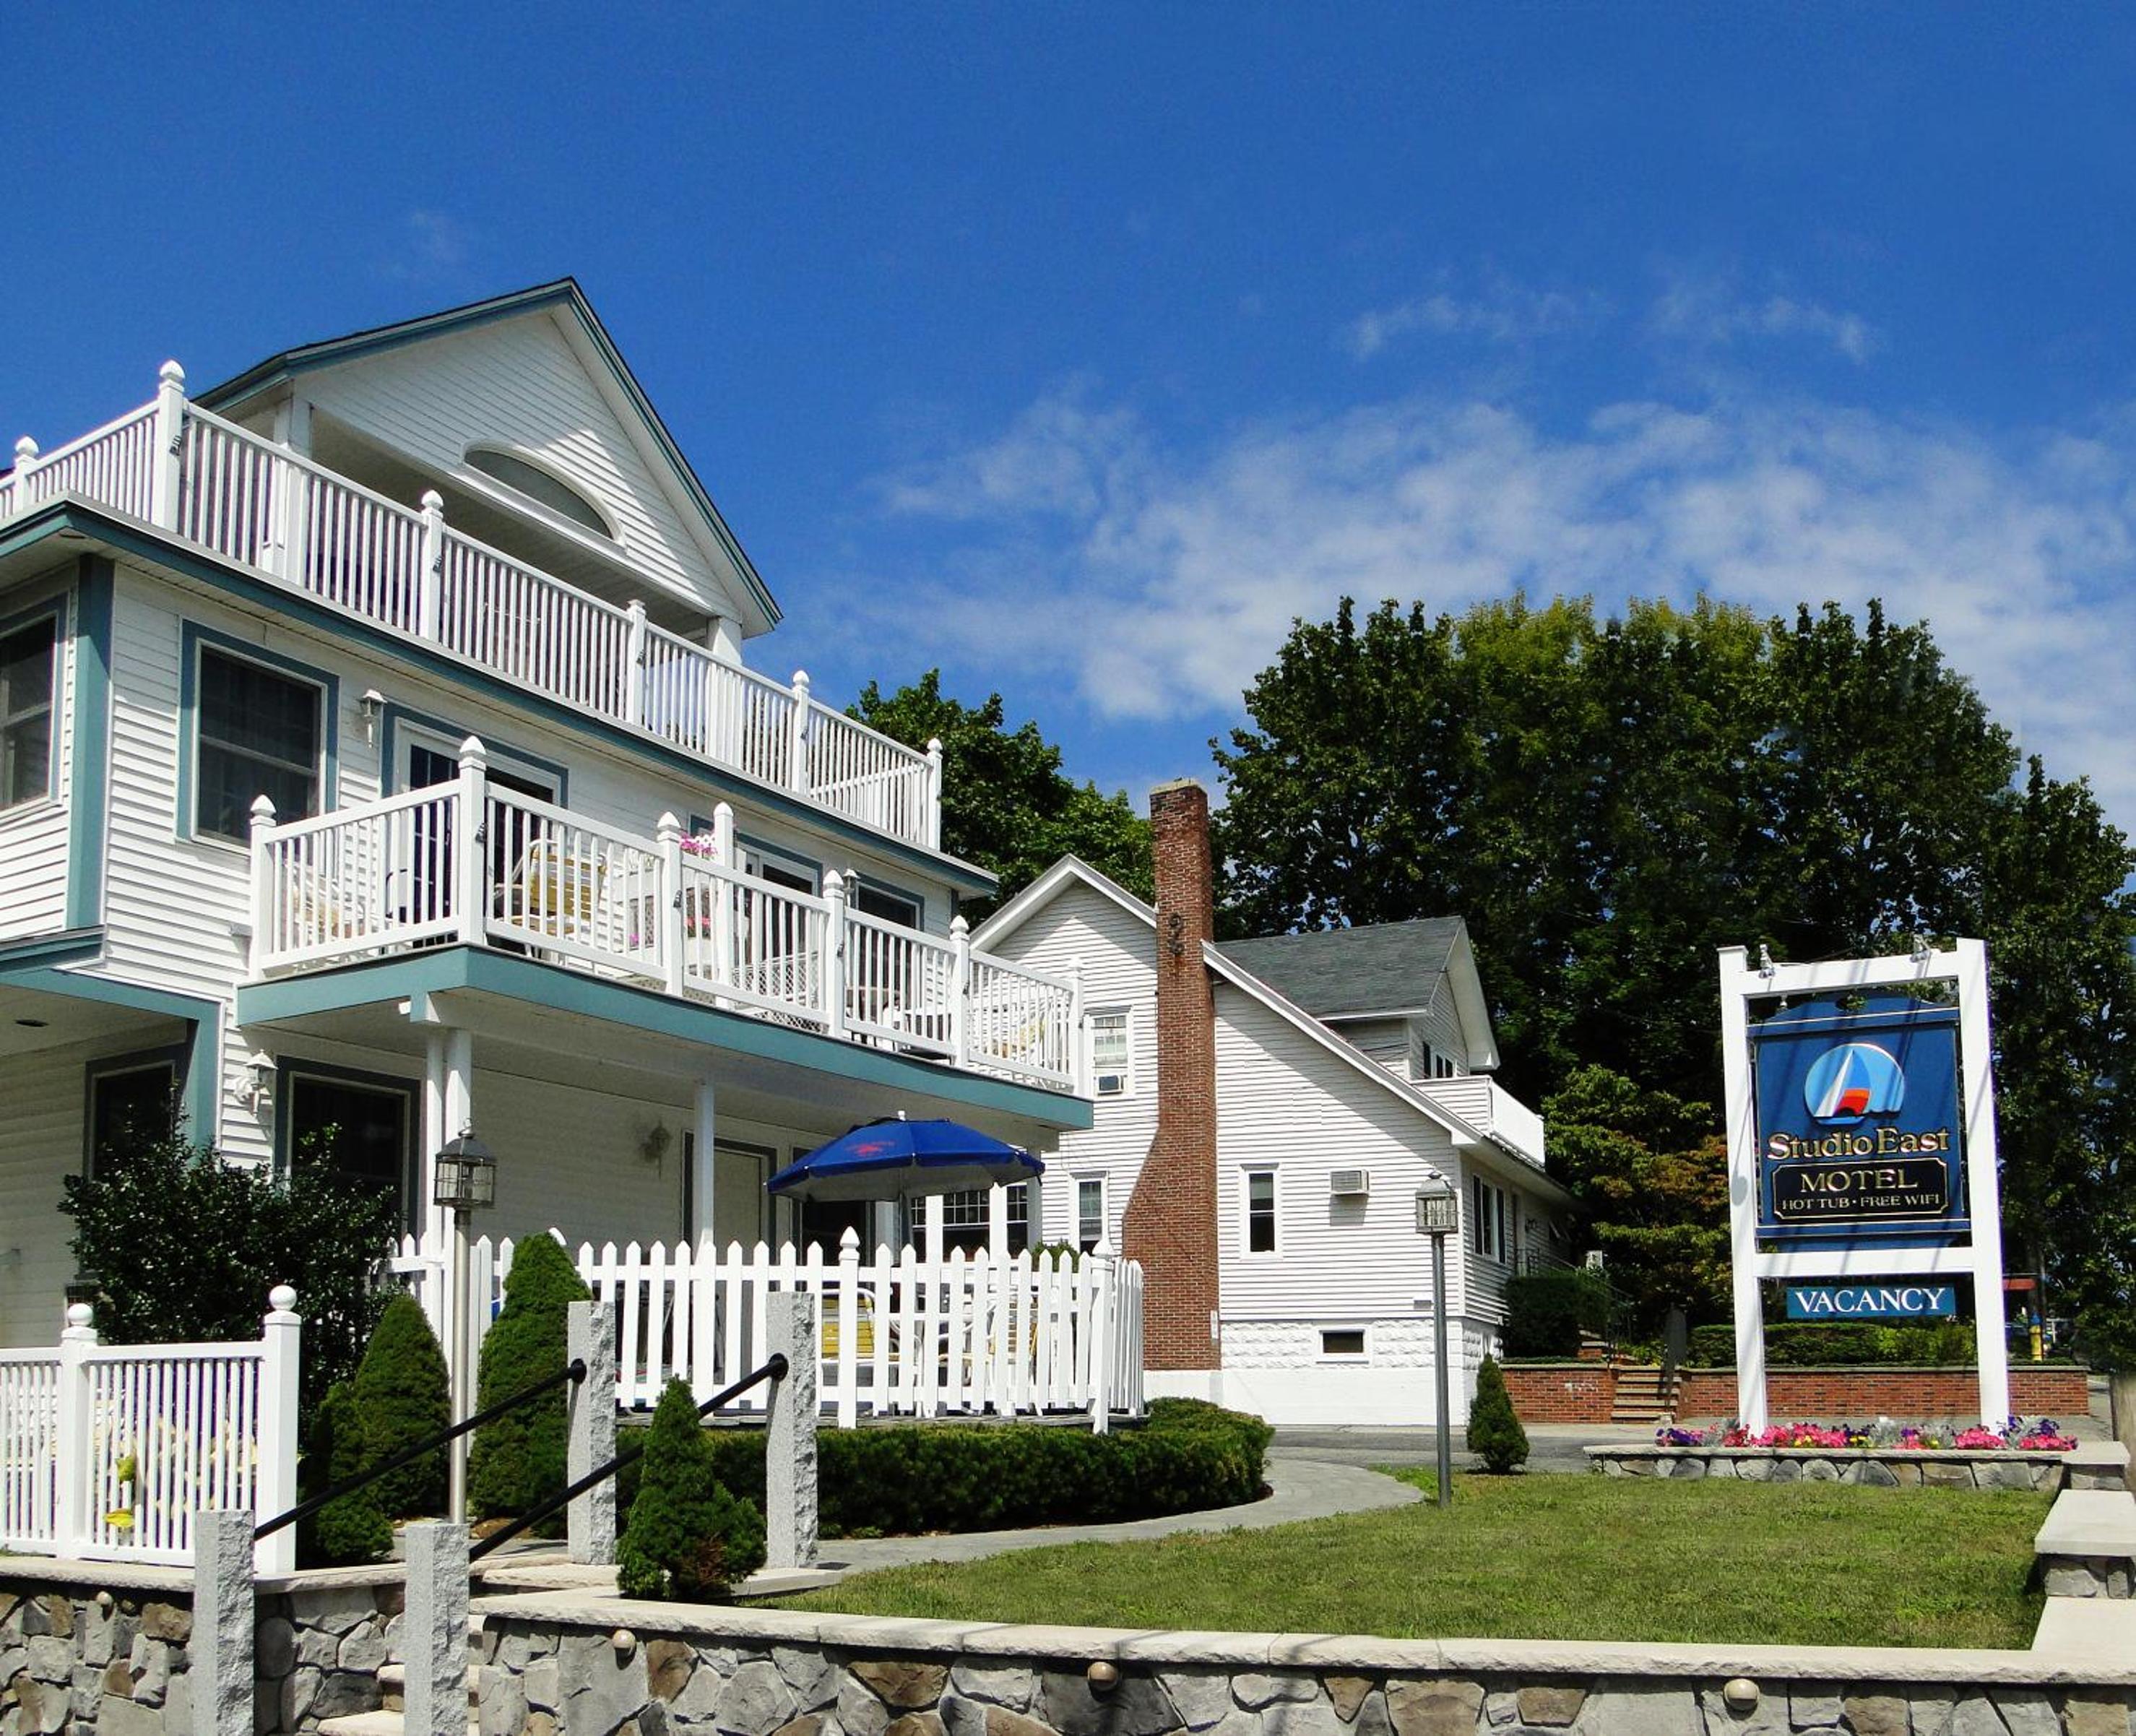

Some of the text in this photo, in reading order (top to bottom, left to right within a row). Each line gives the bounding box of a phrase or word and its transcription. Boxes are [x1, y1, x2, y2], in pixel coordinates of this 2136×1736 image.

[1768, 1127, 1950, 1160] Studio East
[1800, 1169, 1918, 1192] MOTEL
[1782, 1193, 1940, 1210] HOT TUB FREE WIFI
[1795, 1288, 1945, 1313] VACANCY
